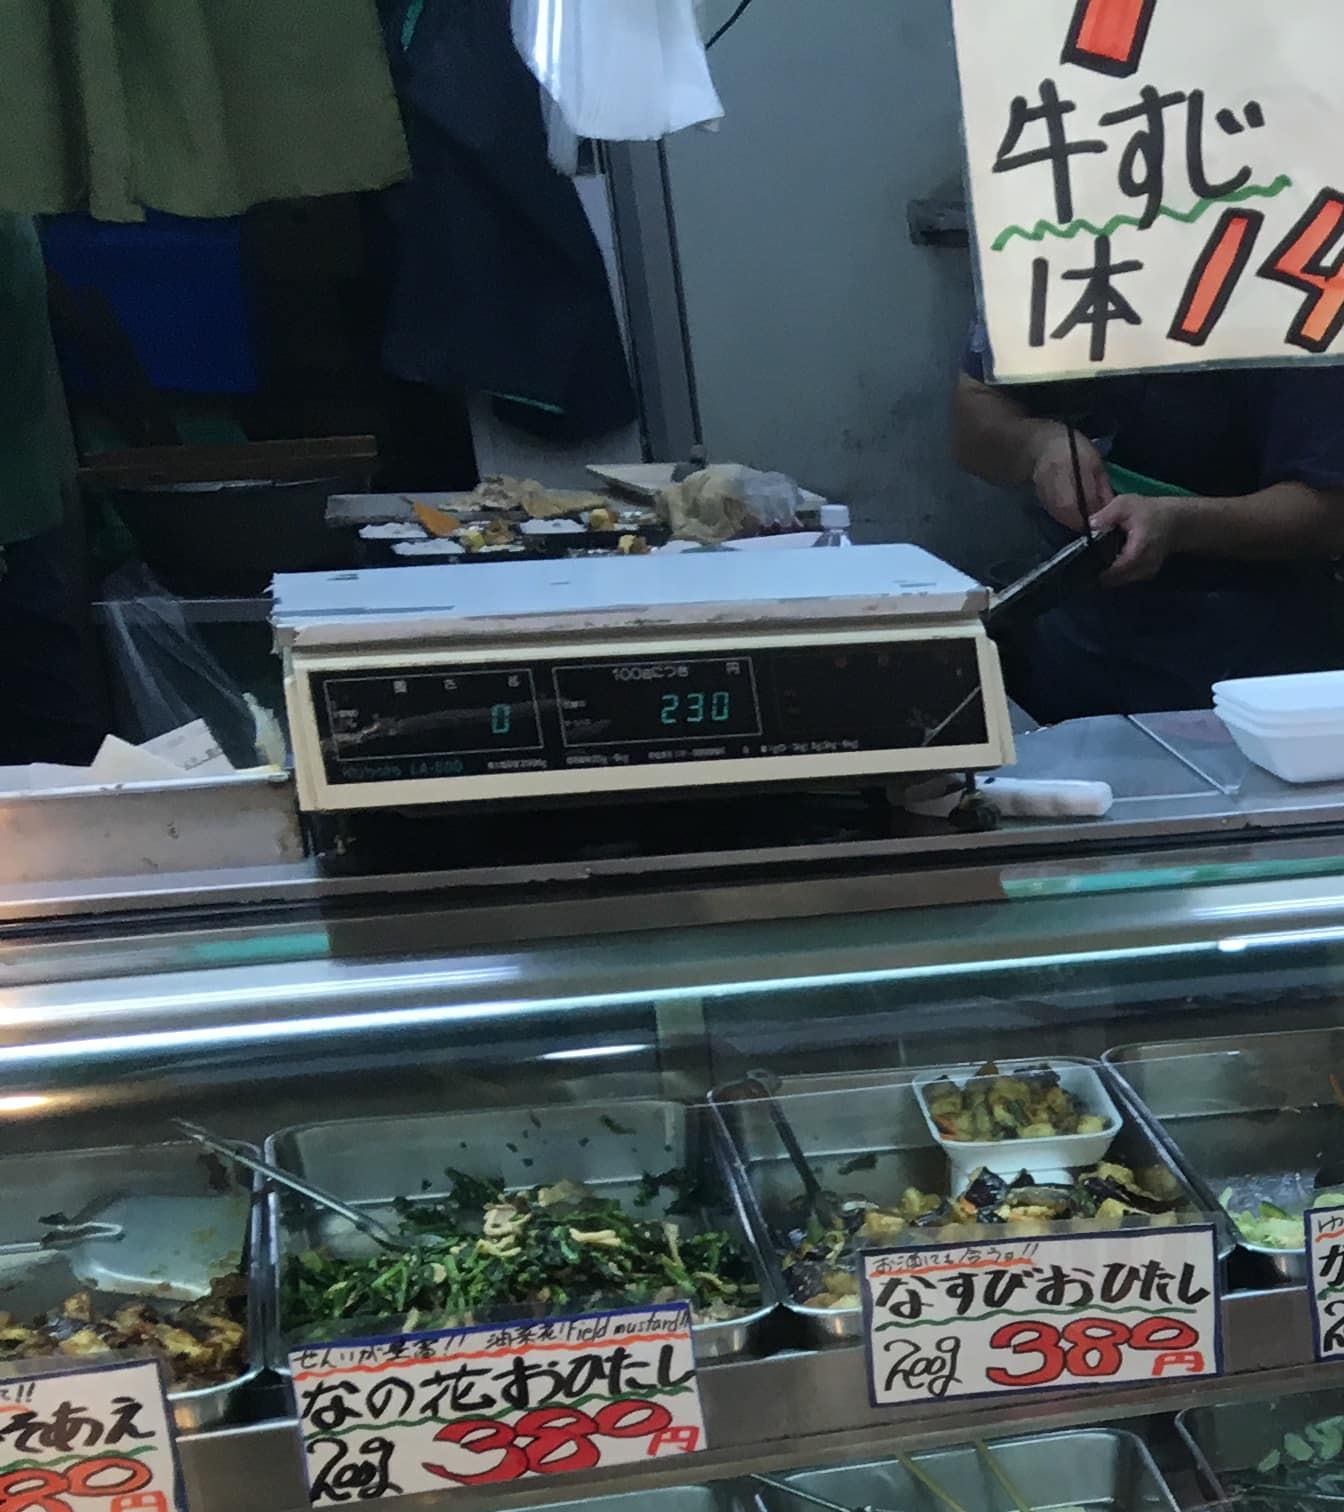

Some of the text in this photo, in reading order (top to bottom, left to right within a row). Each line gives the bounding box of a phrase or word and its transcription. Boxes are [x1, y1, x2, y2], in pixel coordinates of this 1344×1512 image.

[992, 78, 1265, 229] 牛すじ
[1028, 235, 1142, 361] 1本
[491, 703, 511, 734] 0
[661, 691, 729, 724] 230
[875, 1258, 1212, 1320] なすびおひたし
[303, 1344, 696, 1429] なの花おひたし
